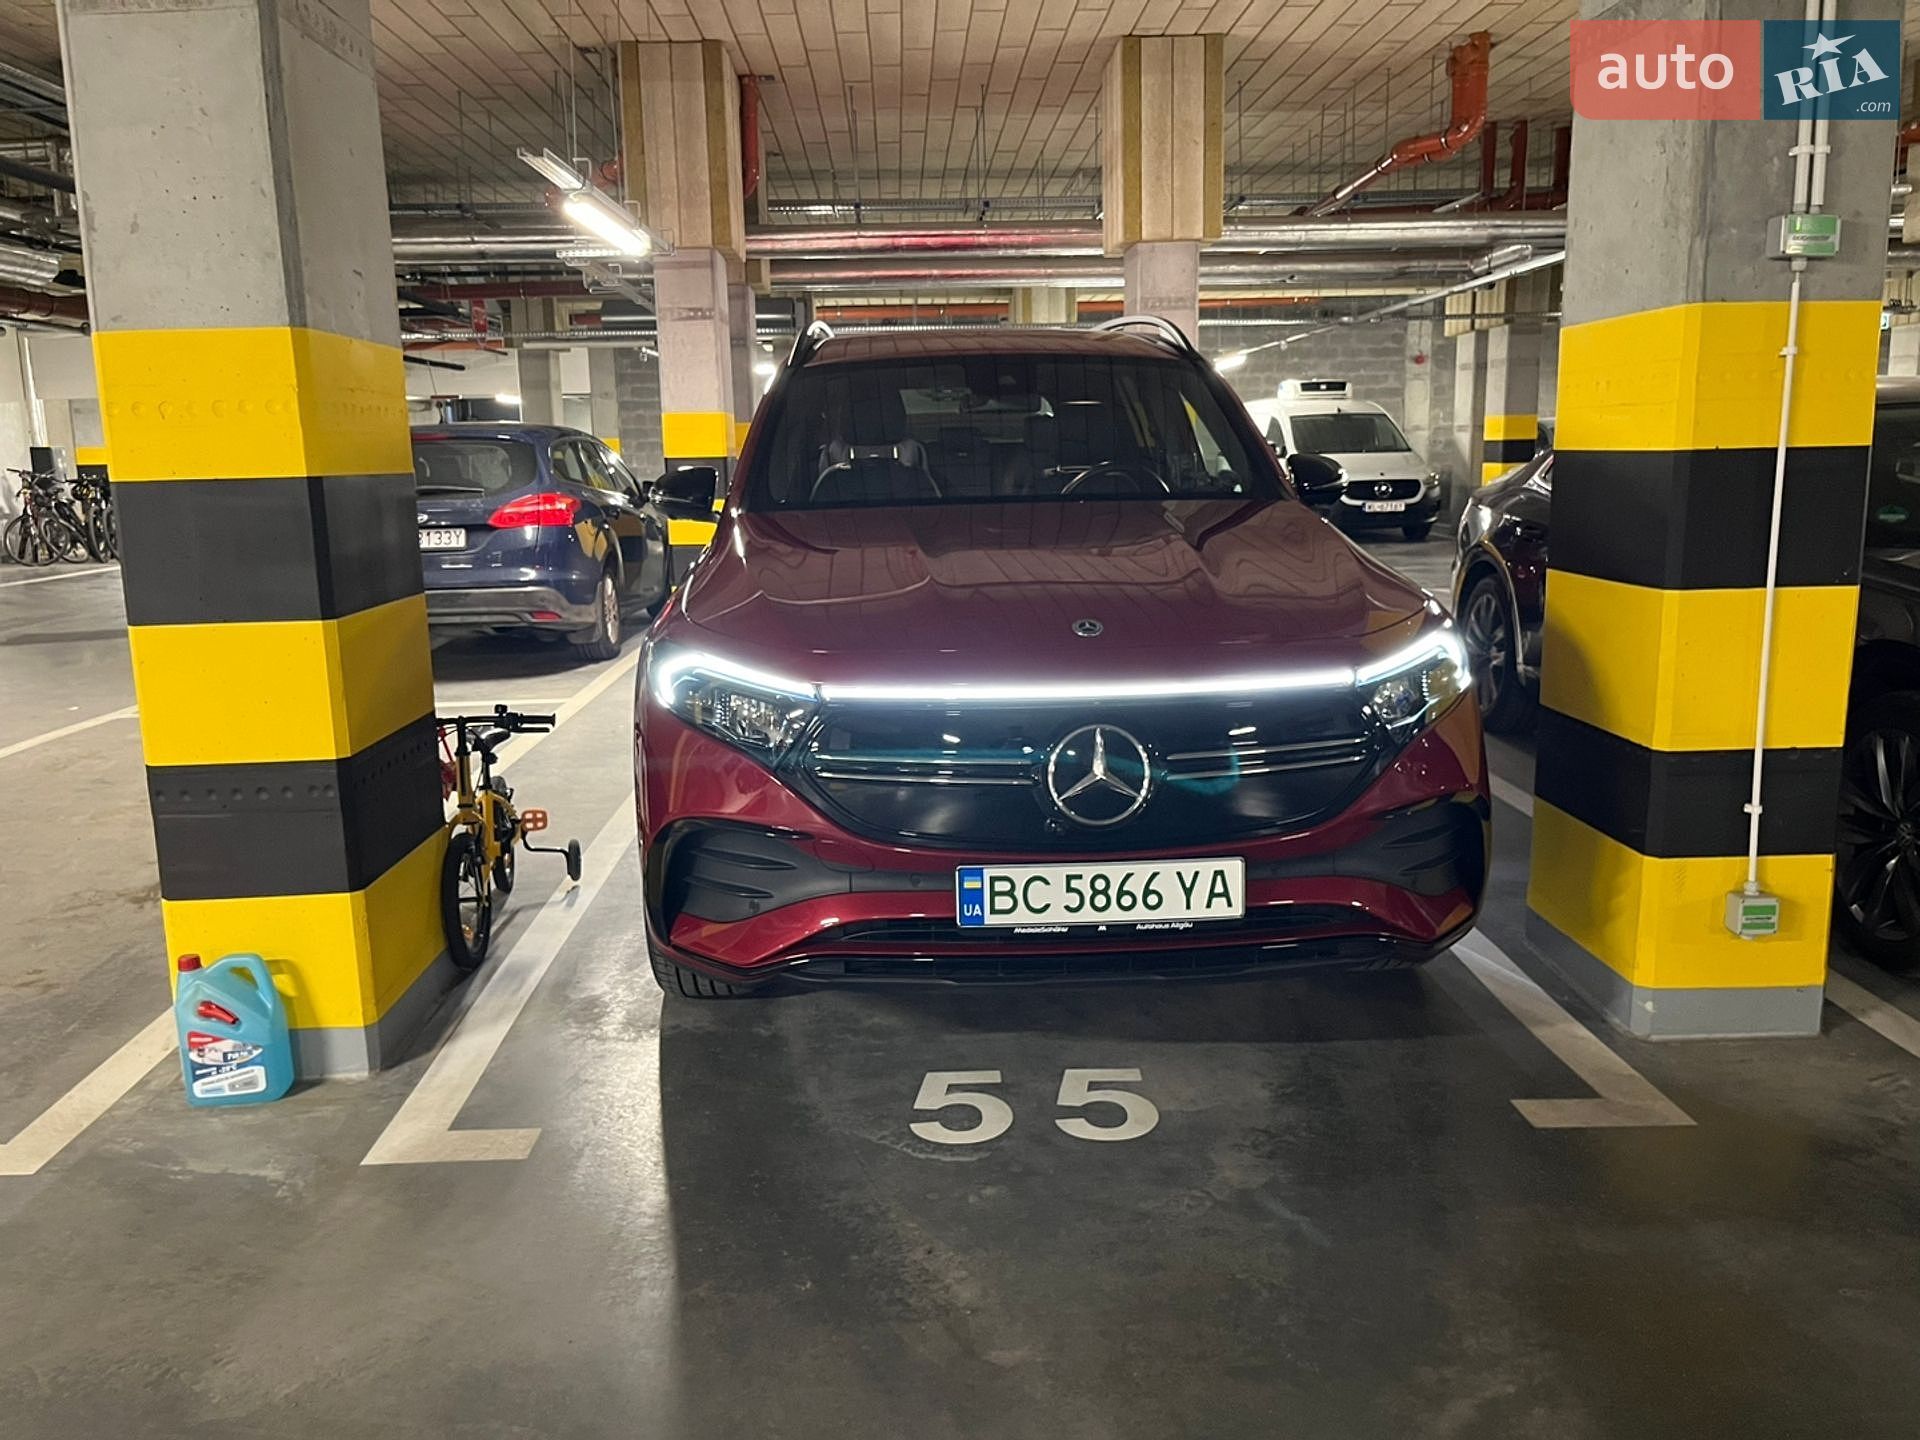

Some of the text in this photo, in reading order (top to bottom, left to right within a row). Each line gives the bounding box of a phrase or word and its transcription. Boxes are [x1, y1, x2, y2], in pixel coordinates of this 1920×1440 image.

[963, 902, 982, 917] UA
[988, 868, 1233, 916] BC 5866 YA
[908, 1068, 1161, 1145] 55
